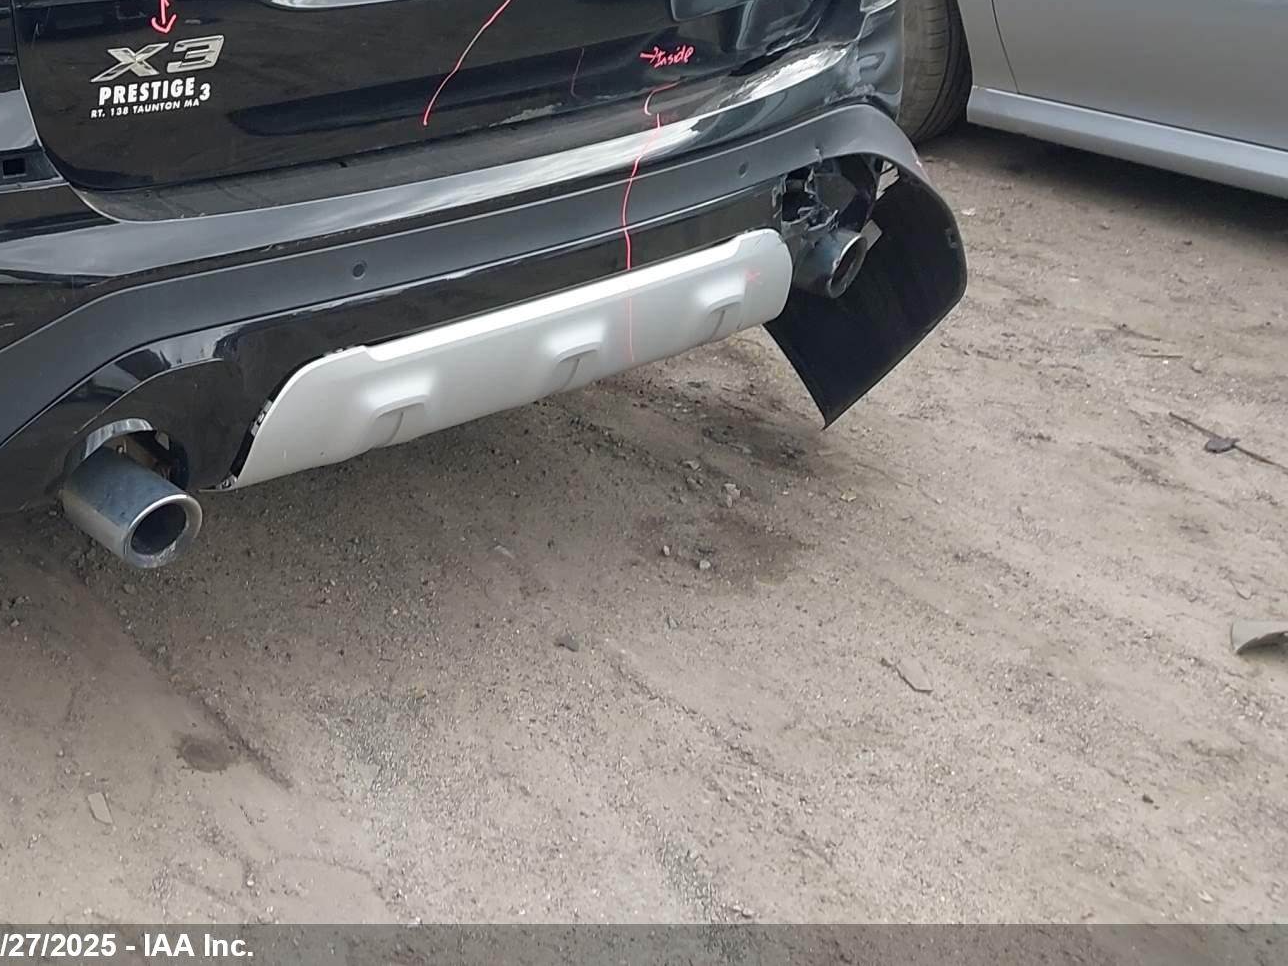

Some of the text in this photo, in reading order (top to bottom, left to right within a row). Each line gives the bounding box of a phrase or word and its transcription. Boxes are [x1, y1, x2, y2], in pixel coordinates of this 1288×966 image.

[90, 34, 224, 83] X3
[98, 77, 211, 106] PRESTIGE 3
[90, 98, 200, 119] RT. 138 TAUNTON MA
